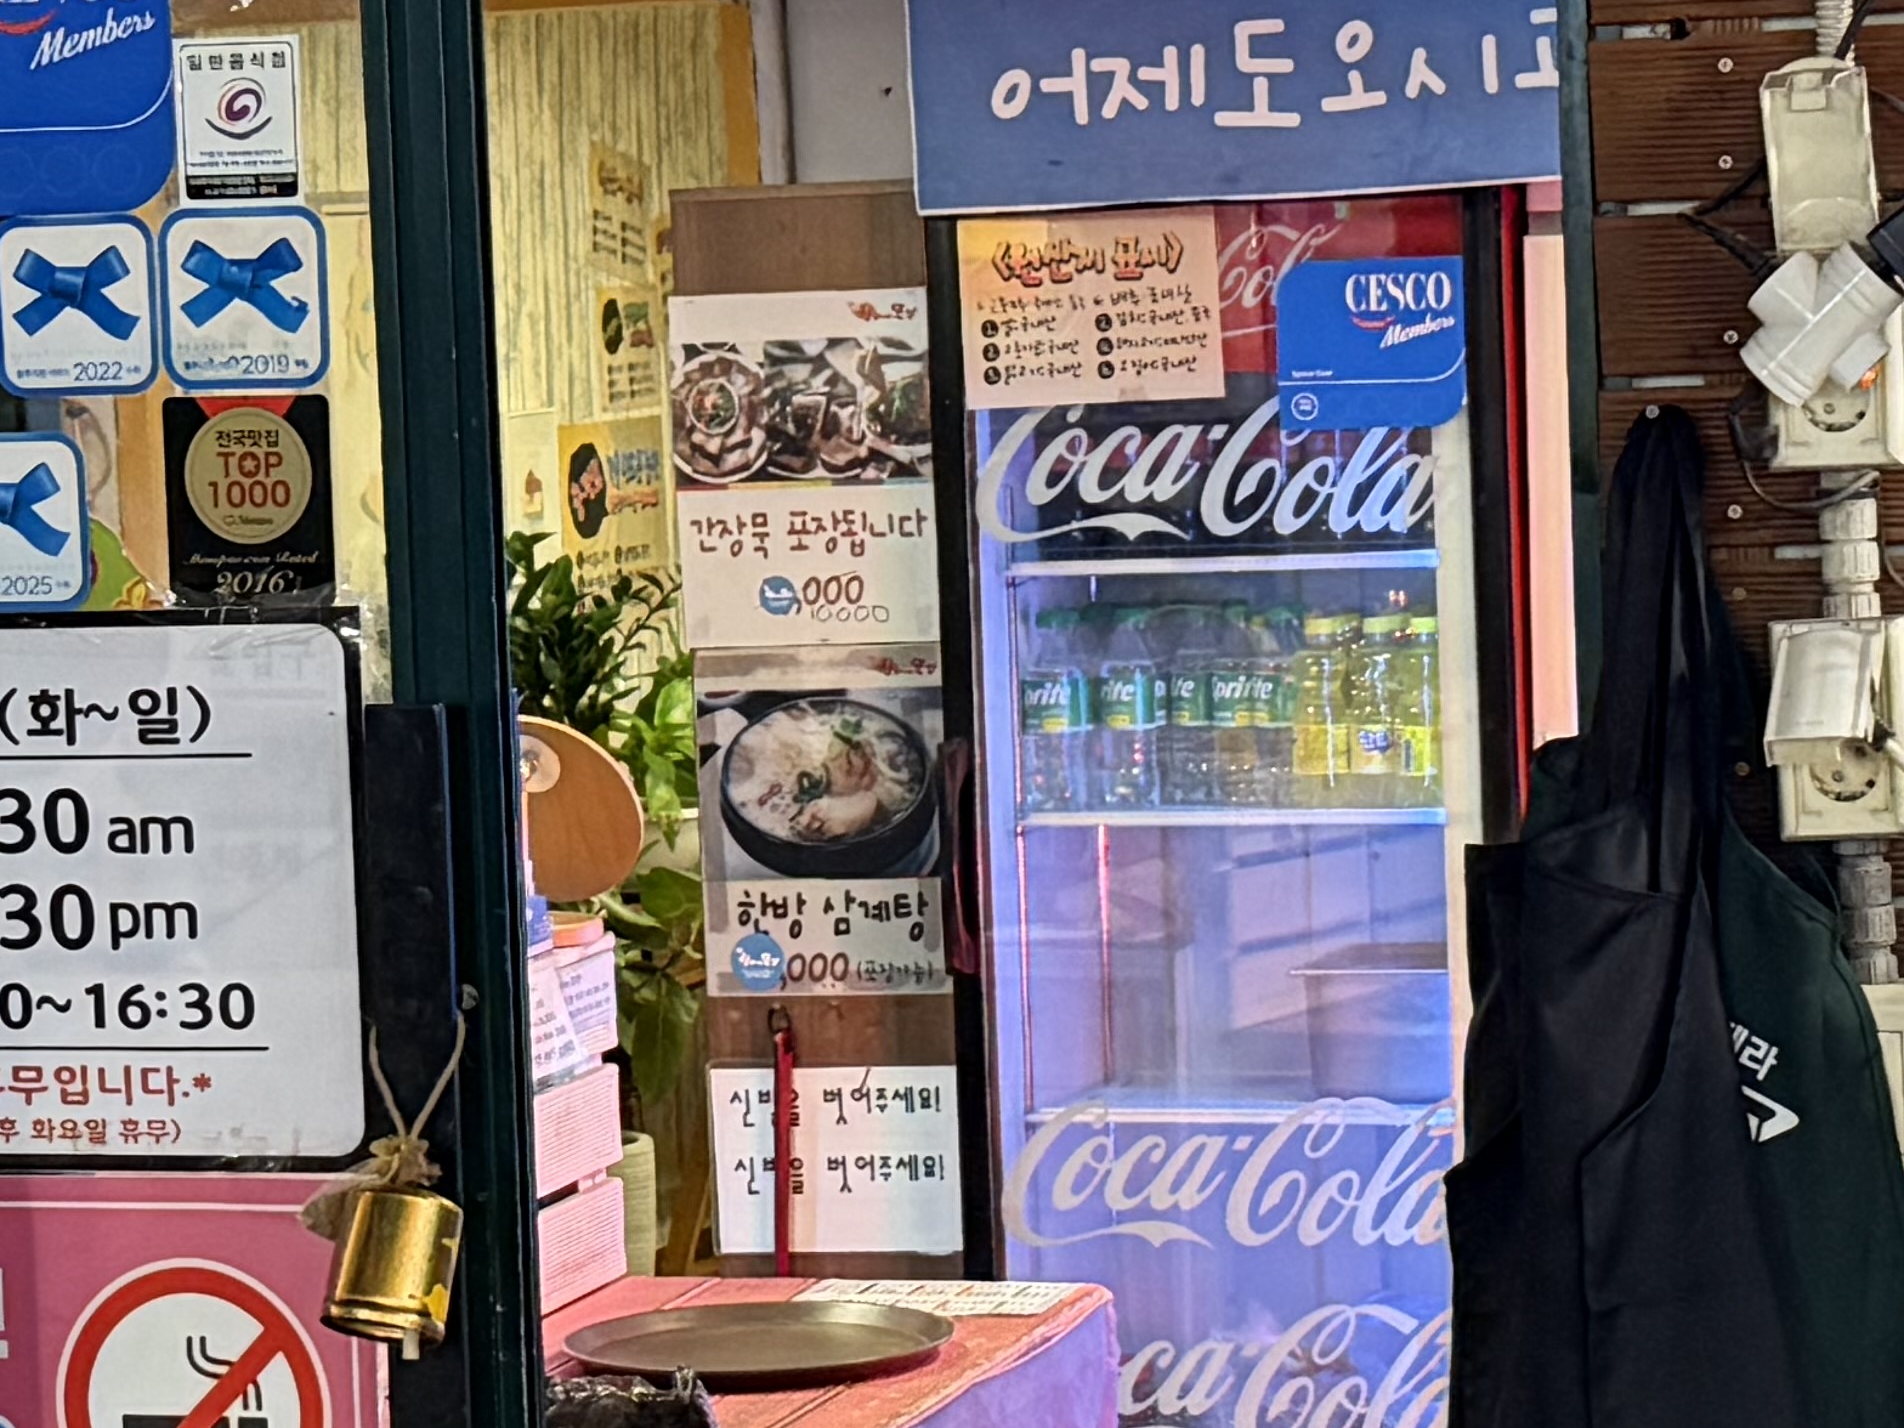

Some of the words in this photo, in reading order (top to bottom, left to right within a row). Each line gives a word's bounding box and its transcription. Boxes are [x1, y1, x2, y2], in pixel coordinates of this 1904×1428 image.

[30, 10, 155, 70] Members
[1345, 271, 1452, 313] CESCO
[1379, 313, 1455, 349] Members
[73, 361, 123, 382] 2022
[216, 451, 283, 479] TOP
[208, 480, 291, 509] 1000
[690, 512, 771, 559] 간장묵
[787, 508, 929, 558] 포장됩니다
[1, 576, 53, 596] 2025
[106, 811, 196, 856] am
[108, 896, 199, 949] pm
[737, 890, 807, 939] 한방
[823, 889, 929, 942] 삼계탕
[30, 1119, 108, 1145] 화요일
[117, 1119, 184, 1146] 휴무)
